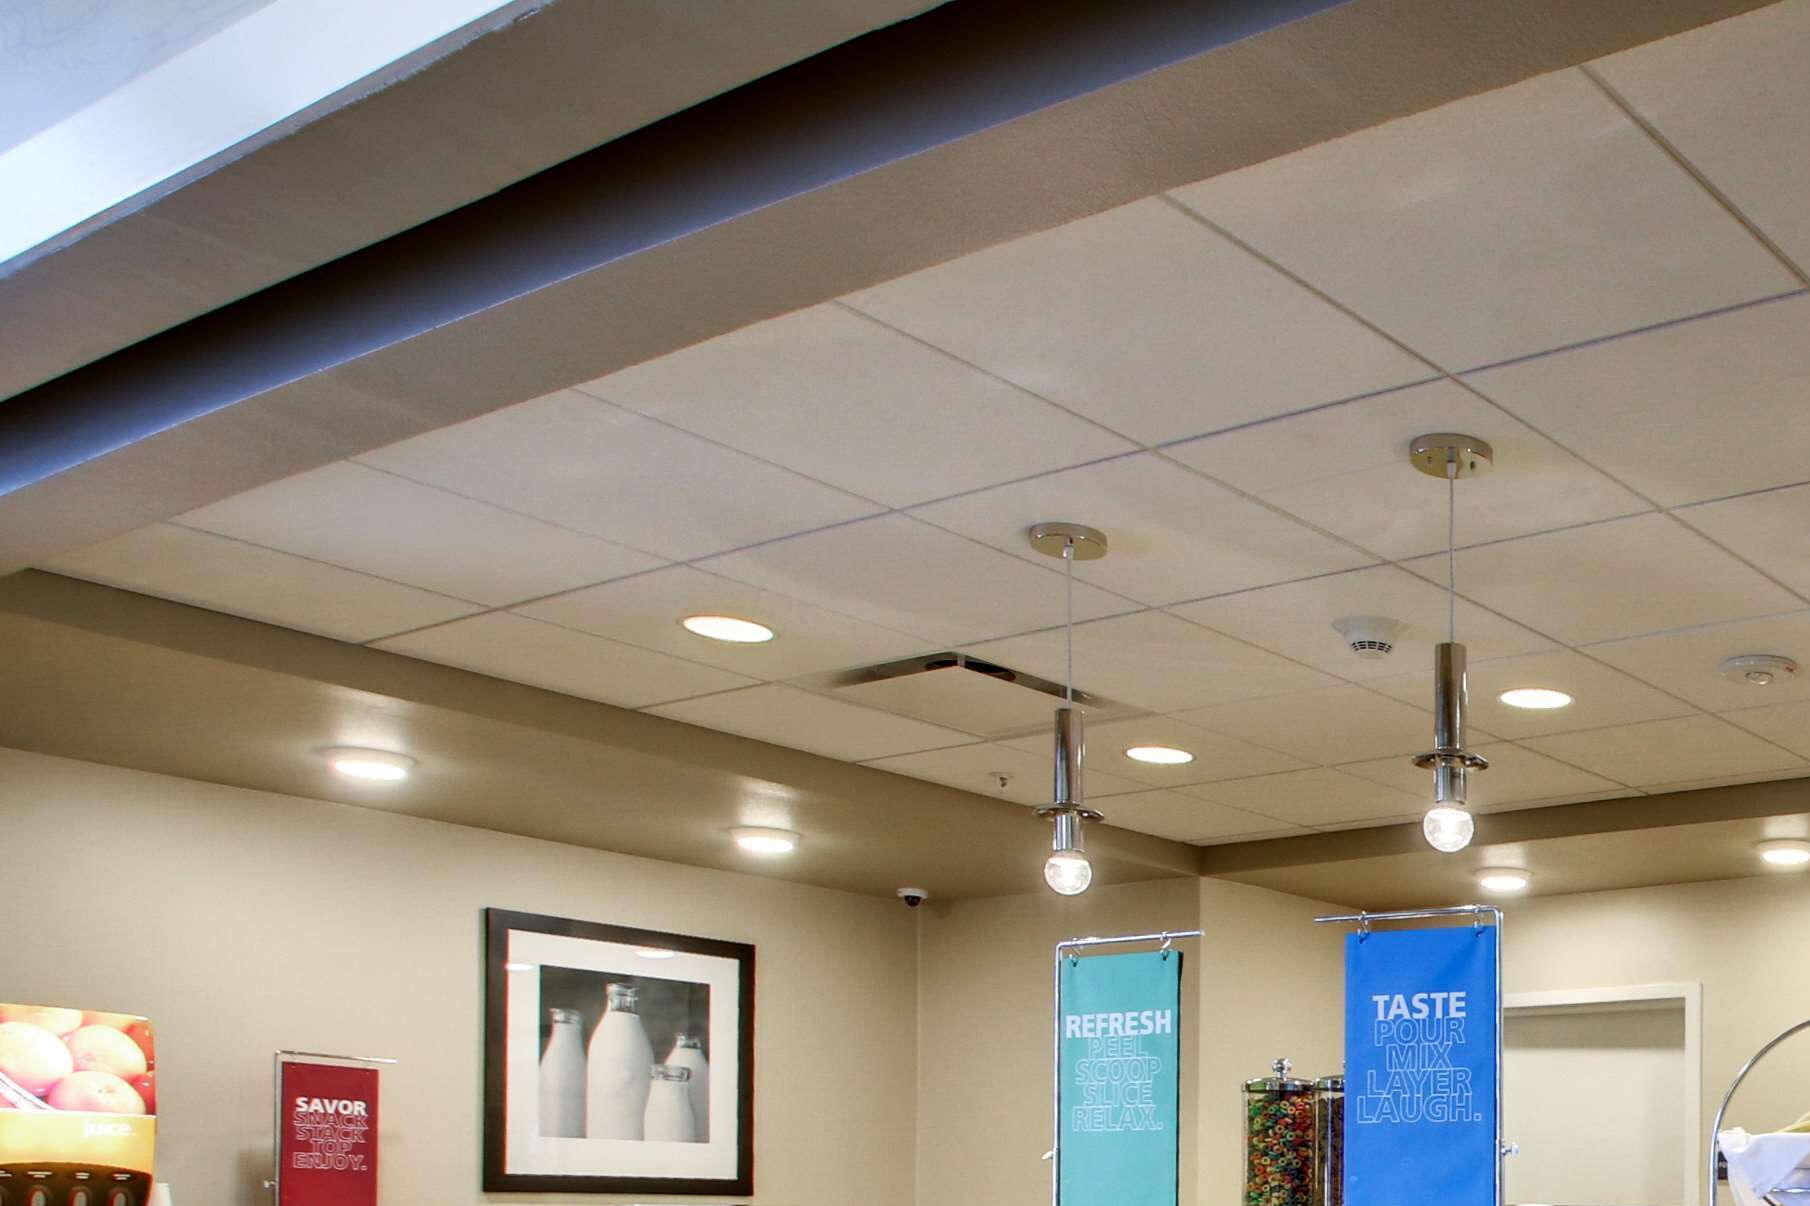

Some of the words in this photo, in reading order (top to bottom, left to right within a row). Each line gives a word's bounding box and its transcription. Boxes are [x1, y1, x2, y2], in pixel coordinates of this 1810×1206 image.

[1372, 991, 1466, 1021] TASTE
[1065, 1009, 1172, 1039] REFRESH
[1374, 1016, 1466, 1047] POUR
[1088, 1034, 1149, 1060] PEEL
[1386, 1042, 1453, 1072] MIX
[1075, 1056, 1161, 1085] SCOOP
[1367, 1067, 1472, 1097] LAYER
[295, 1096, 367, 1116] SAVOR
[1082, 1080, 1153, 1107] SLICE
[293, 1111, 369, 1129] SNACK
[1072, 1104, 1164, 1132] RELAX.
[1356, 1094, 1482, 1124] LAUGH.
[295, 1125, 366, 1143] STACK
[310, 1138, 352, 1156] TOP
[293, 1151, 368, 1171] ENJOY.
